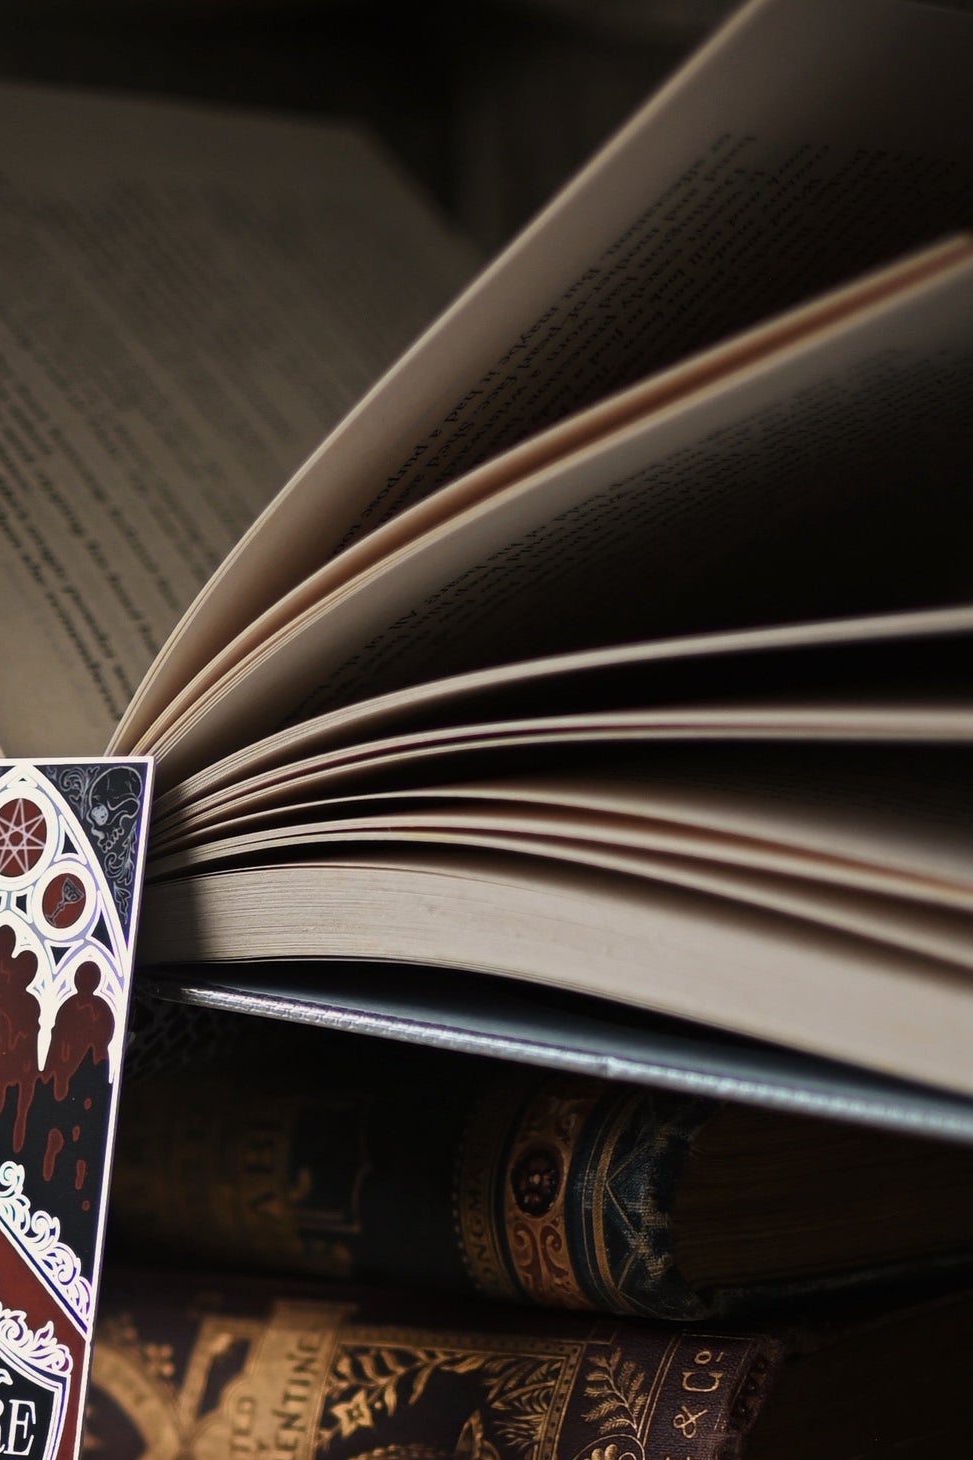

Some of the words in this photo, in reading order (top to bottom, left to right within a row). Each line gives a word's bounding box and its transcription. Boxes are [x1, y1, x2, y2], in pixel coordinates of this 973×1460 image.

[500, 308, 557, 364] maybe
[445, 391, 482, 421] had
[363, 446, 427, 516] purpose
[672, 1404, 708, 1439] &
